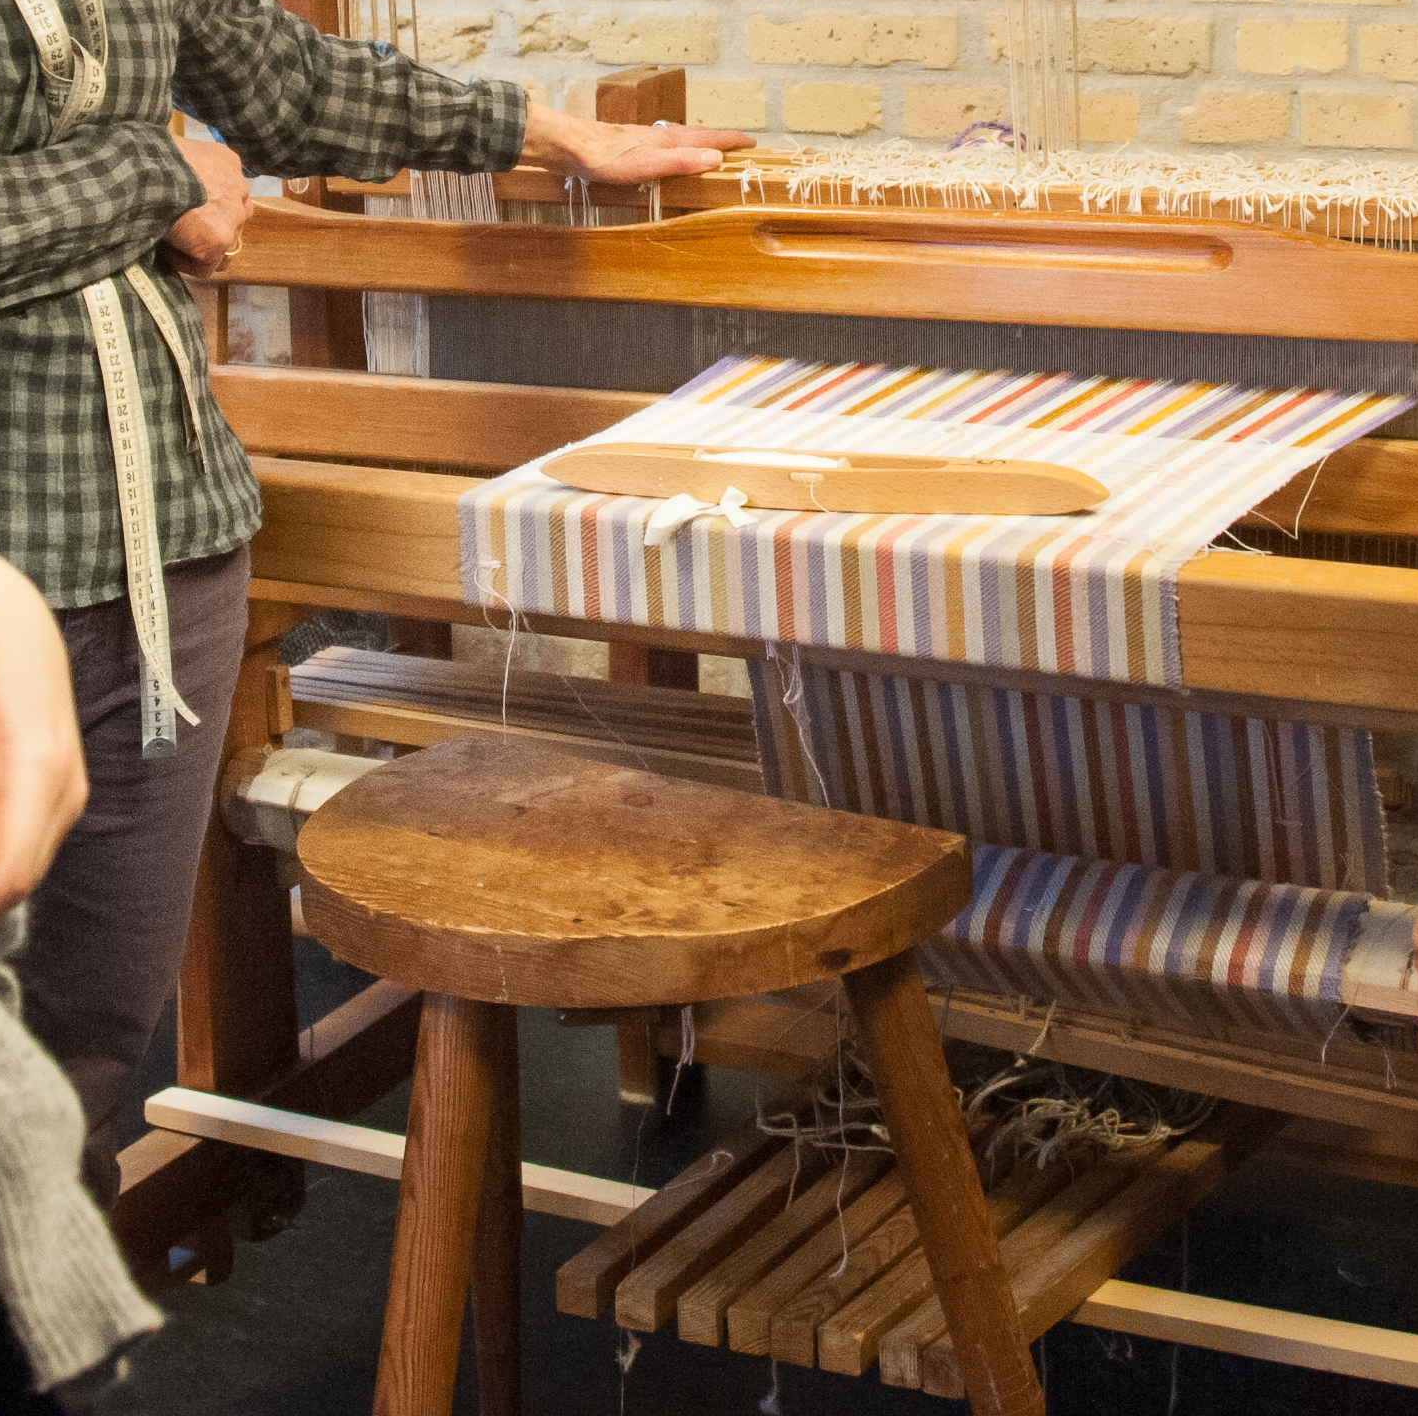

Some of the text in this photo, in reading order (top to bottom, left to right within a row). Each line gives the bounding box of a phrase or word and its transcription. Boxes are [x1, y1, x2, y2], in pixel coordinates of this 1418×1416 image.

[32, 4, 45, 16] 32
[39, 18, 51, 30] 31
[47, 32, 59, 46] 30
[51, 48, 63, 60] 29
[95, 290, 105, 302] 27
[99, 306, 111, 317] 26
[103, 322, 114, 334] 25
[106, 339, 117, 350] 24
[109, 355, 121, 366] 23
[113, 372, 124, 383] 22
[116, 388, 126, 400] 21
[117, 406, 128, 416] 20
[119, 422, 129, 433] 19
[121, 439, 132, 450] 18
[125, 455, 133, 467] 17
[127, 472, 135, 484] 16
[127, 488, 137, 500] 15
[130, 506, 139, 517] 14
[131, 522, 139, 534] 13
[133, 540, 141, 550] 12
[135, 556, 141, 566] 11
[153, 680, 159, 692] 5
[155, 712, 161, 722] 3
[155, 728, 161, 736] 2
